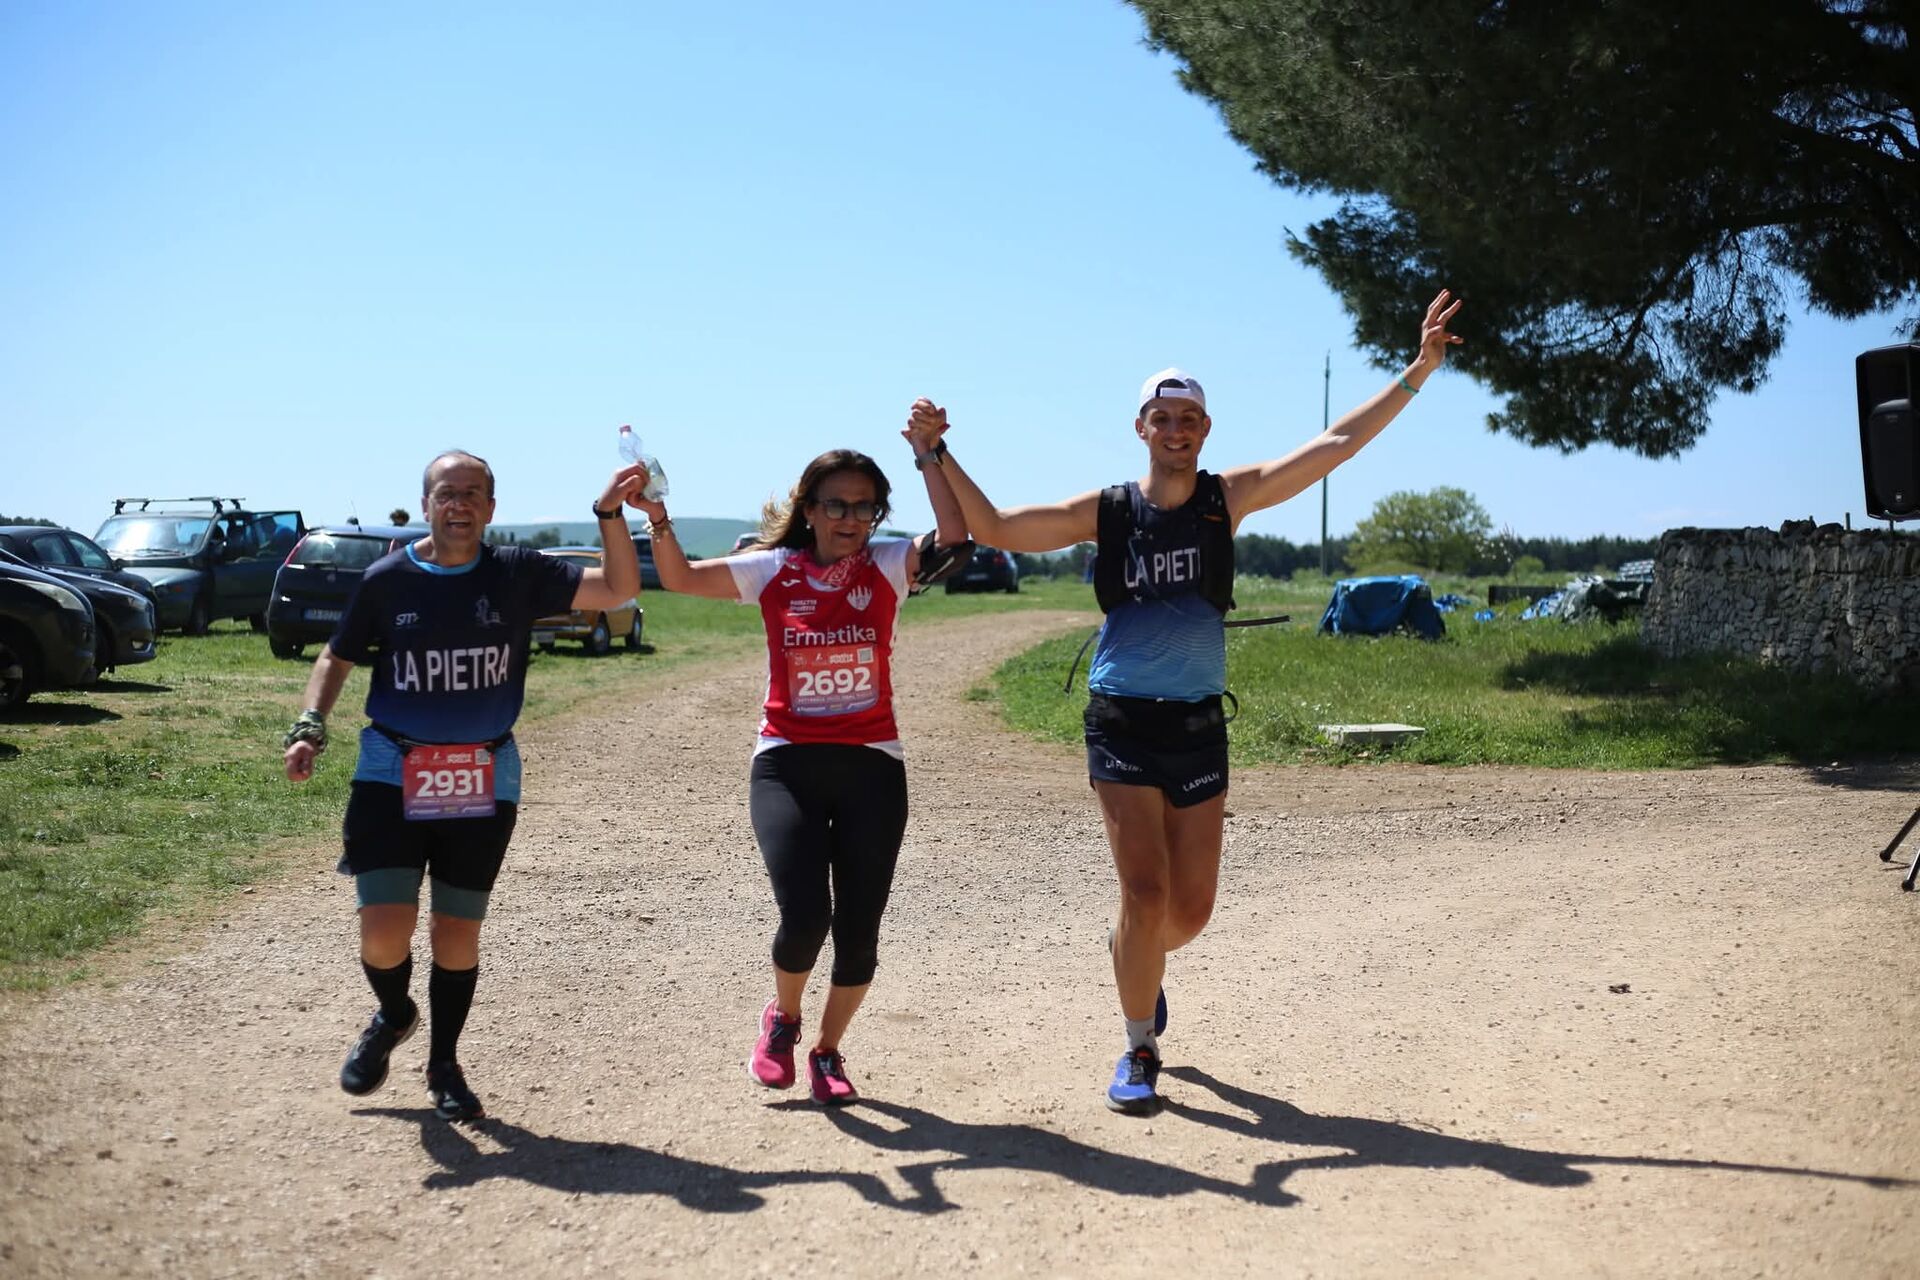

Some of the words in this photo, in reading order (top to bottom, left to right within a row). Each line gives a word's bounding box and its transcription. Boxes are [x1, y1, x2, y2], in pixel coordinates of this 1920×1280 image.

[1124, 554, 1149, 588] LA
[1153, 546, 1201, 584] PIET
[784, 626, 876, 646] Ermetika
[393, 650, 420, 692] LA
[426, 644, 510, 692] PIETRA
[798, 667, 871, 696] 2692
[416, 768, 484, 798] 2931
